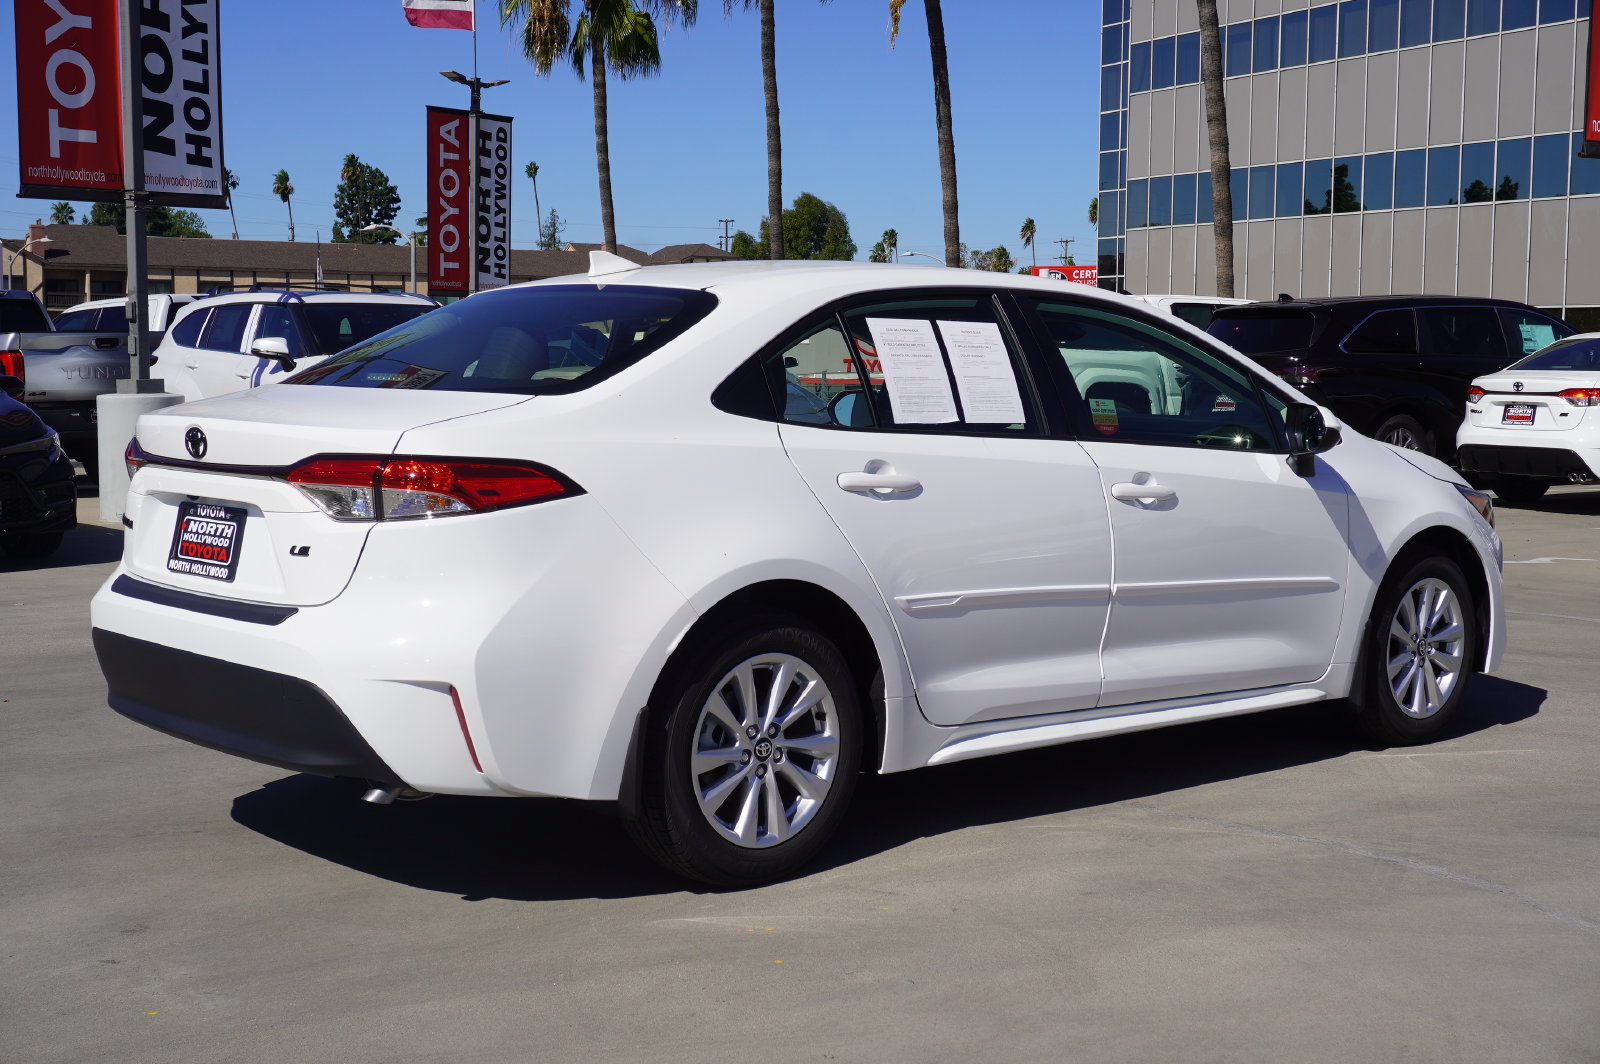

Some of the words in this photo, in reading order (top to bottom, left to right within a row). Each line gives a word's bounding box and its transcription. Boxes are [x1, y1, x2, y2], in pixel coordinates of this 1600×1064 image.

[181, 0, 213, 168] HOLLY
[439, 118, 460, 276] TOYOTA
[478, 129, 493, 275] NORTH
[494, 126, 508, 280] HOLLYWOOD
[1072, 270, 1097, 279] CERT
[197, 505, 225, 518] TOYOTA
[188, 521, 234, 538] NORTH
[183, 533, 229, 547] HOLLYWOOD
[181, 541, 227, 561] TOYOTA
[289, 545, 311, 557] LE
[168, 559, 191, 572] NORTH
[190, 562, 229, 579] HOLLYWOOD
